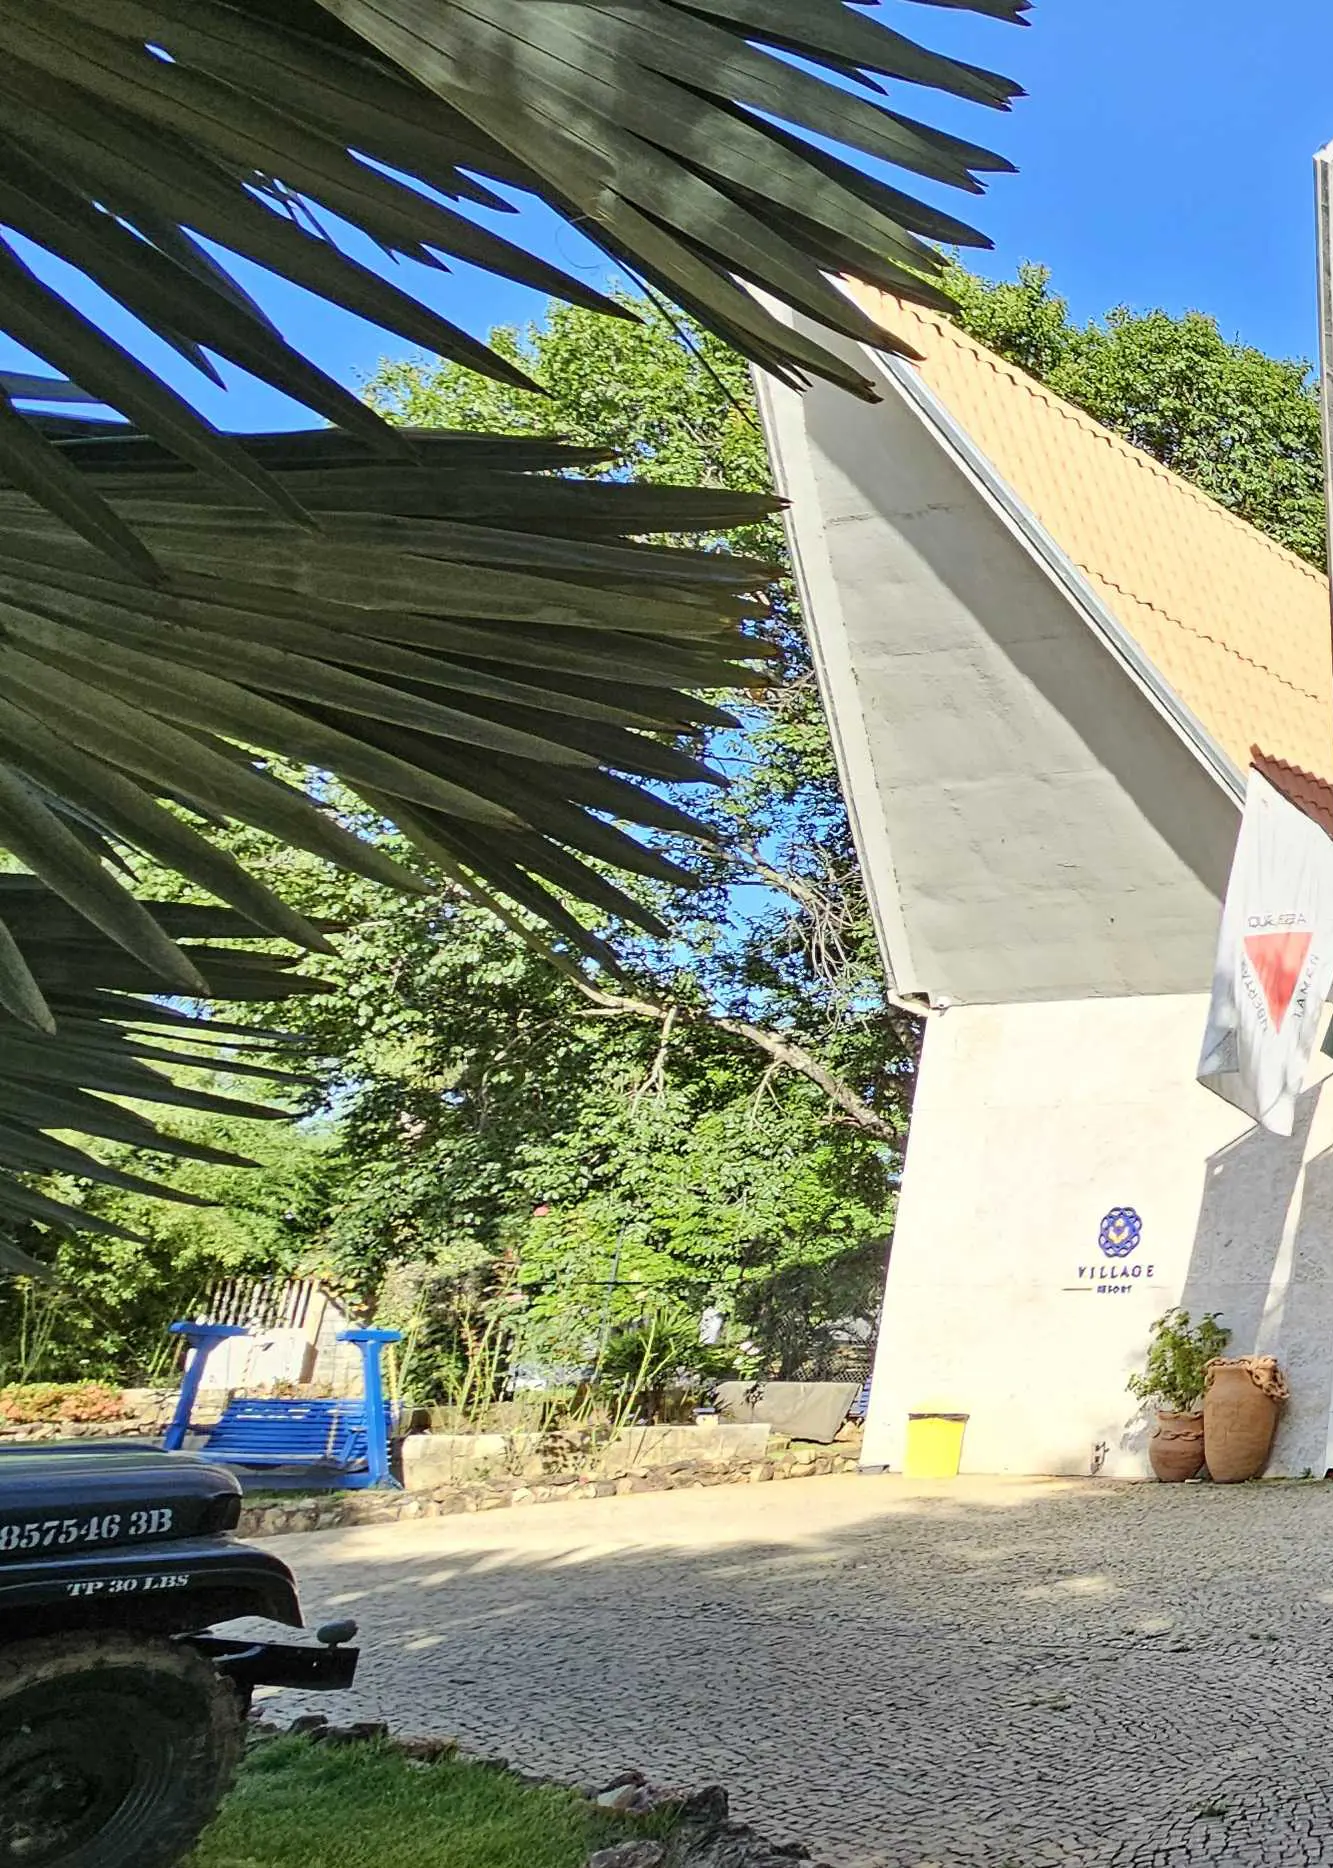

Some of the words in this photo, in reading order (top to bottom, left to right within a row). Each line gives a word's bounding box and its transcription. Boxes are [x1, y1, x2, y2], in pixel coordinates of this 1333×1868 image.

[1078, 1265, 1154, 1279] VILLAGE
[0, 1514, 121, 1550] 857546
[128, 1508, 173, 1535] 3B
[66, 1581, 104, 1597] TP
[108, 1578, 138, 1594] 30
[142, 1574, 190, 1591] LBS
